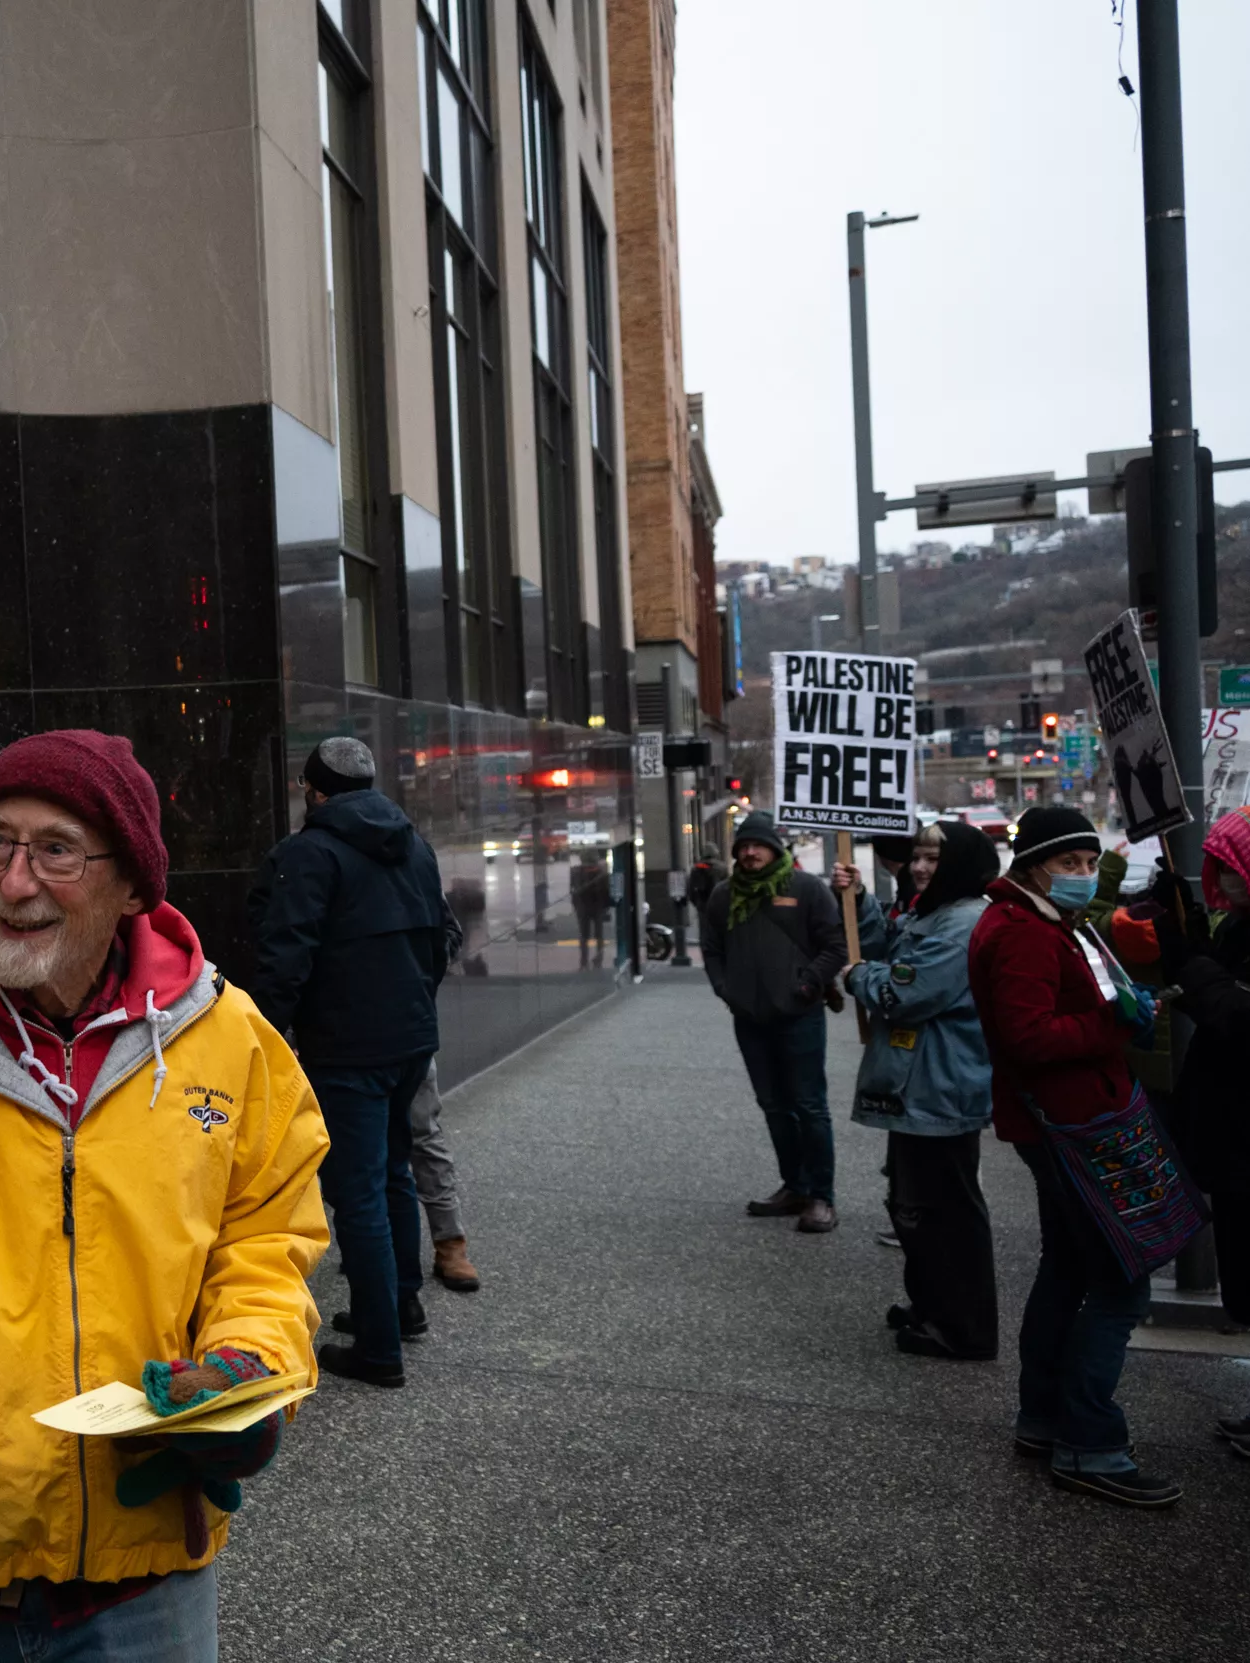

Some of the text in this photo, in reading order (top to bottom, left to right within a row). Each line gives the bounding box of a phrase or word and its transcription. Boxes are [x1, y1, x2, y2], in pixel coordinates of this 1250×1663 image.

[786, 655, 914, 695] PALESTINE
[1084, 622, 1140, 707] FREE
[786, 690, 912, 741] WILL BE
[1099, 681, 1152, 741] PALESTINE
[783, 741, 908, 811] FREE!
[782, 808, 907, 829] A.N.S.W.E.R. Coalition
[184, 1086, 234, 1105] OUTER BANKS
